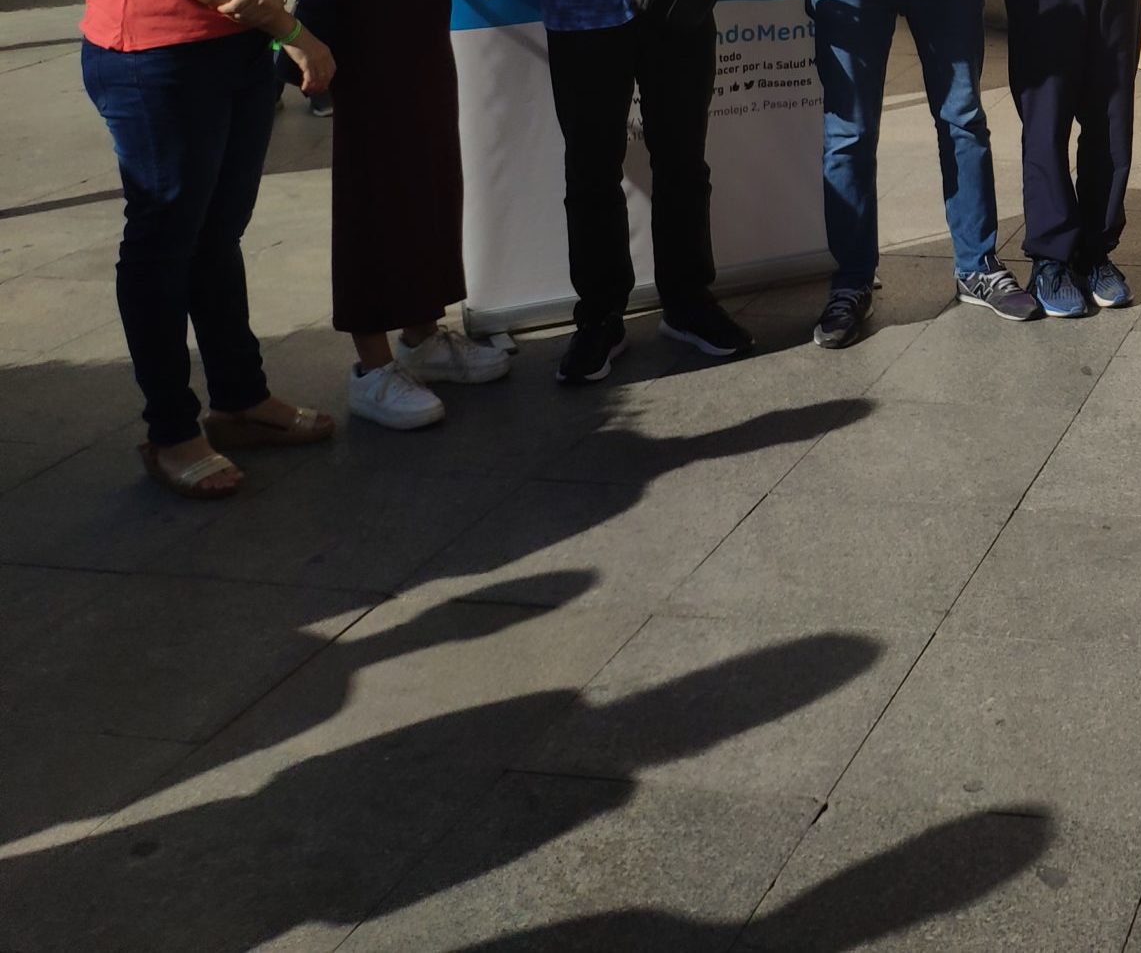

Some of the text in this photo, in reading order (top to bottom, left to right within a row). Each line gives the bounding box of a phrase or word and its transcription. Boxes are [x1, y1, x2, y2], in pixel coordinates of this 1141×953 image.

[715, 21, 816, 45] ndoMent
[719, 52, 742, 63] todo
[715, 65, 739, 76] acer
[743, 62, 760, 74] por
[763, 61, 774, 70] la
[776, 58, 806, 70] Salud
[757, 78, 812, 89] @asaenes
[708, 105, 749, 118] rmolejo
[763, 99, 799, 111] Pasaje
[801, 97, 825, 107] Port
